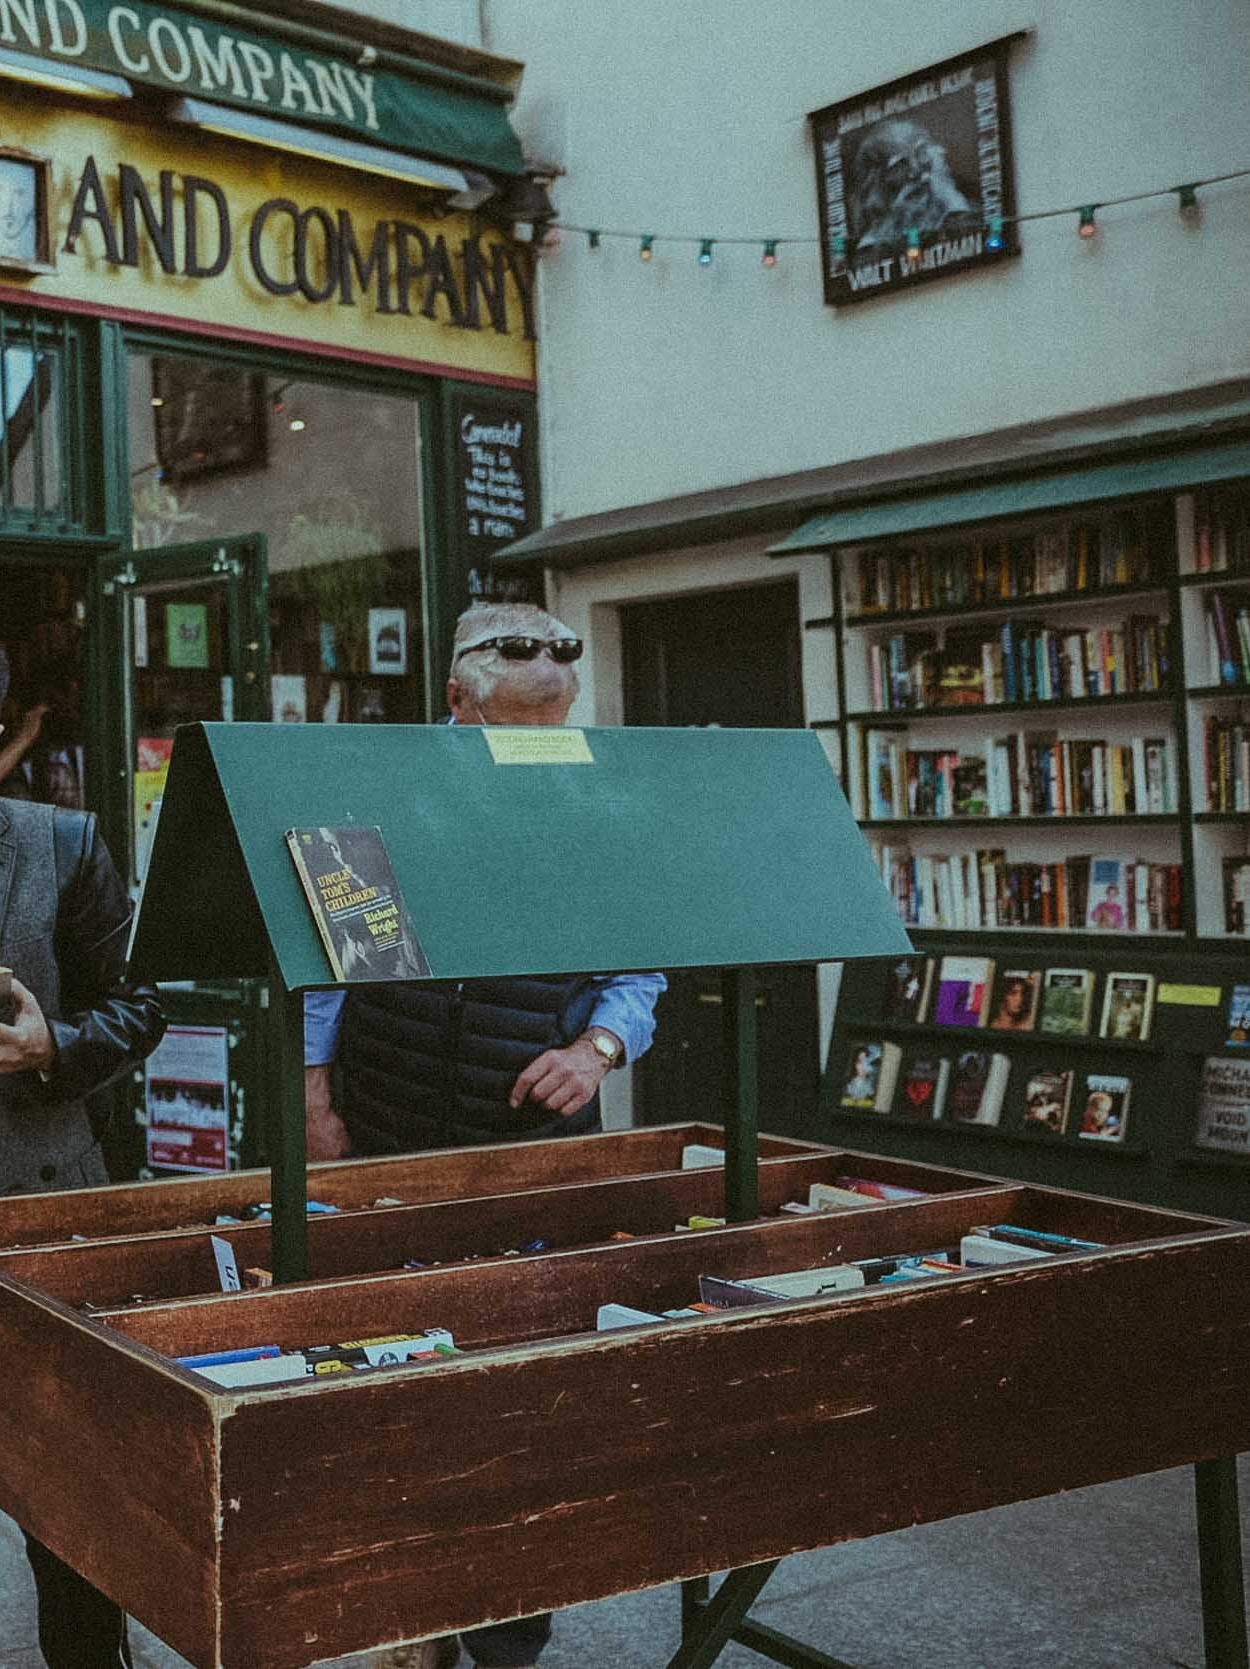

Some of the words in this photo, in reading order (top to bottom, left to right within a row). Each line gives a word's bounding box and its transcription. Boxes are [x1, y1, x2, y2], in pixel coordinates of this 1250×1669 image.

[108, 7, 380, 130] COMPANY
[61, 155, 232, 279] AND
[250, 198, 537, 341] COMPANY
[317, 869, 351, 887] UNCLE
[321, 882, 351, 900] TOM'S
[325, 886, 378, 912] CHILDREN
[364, 904, 399, 924] Richard
[368, 919, 399, 936] Wright
